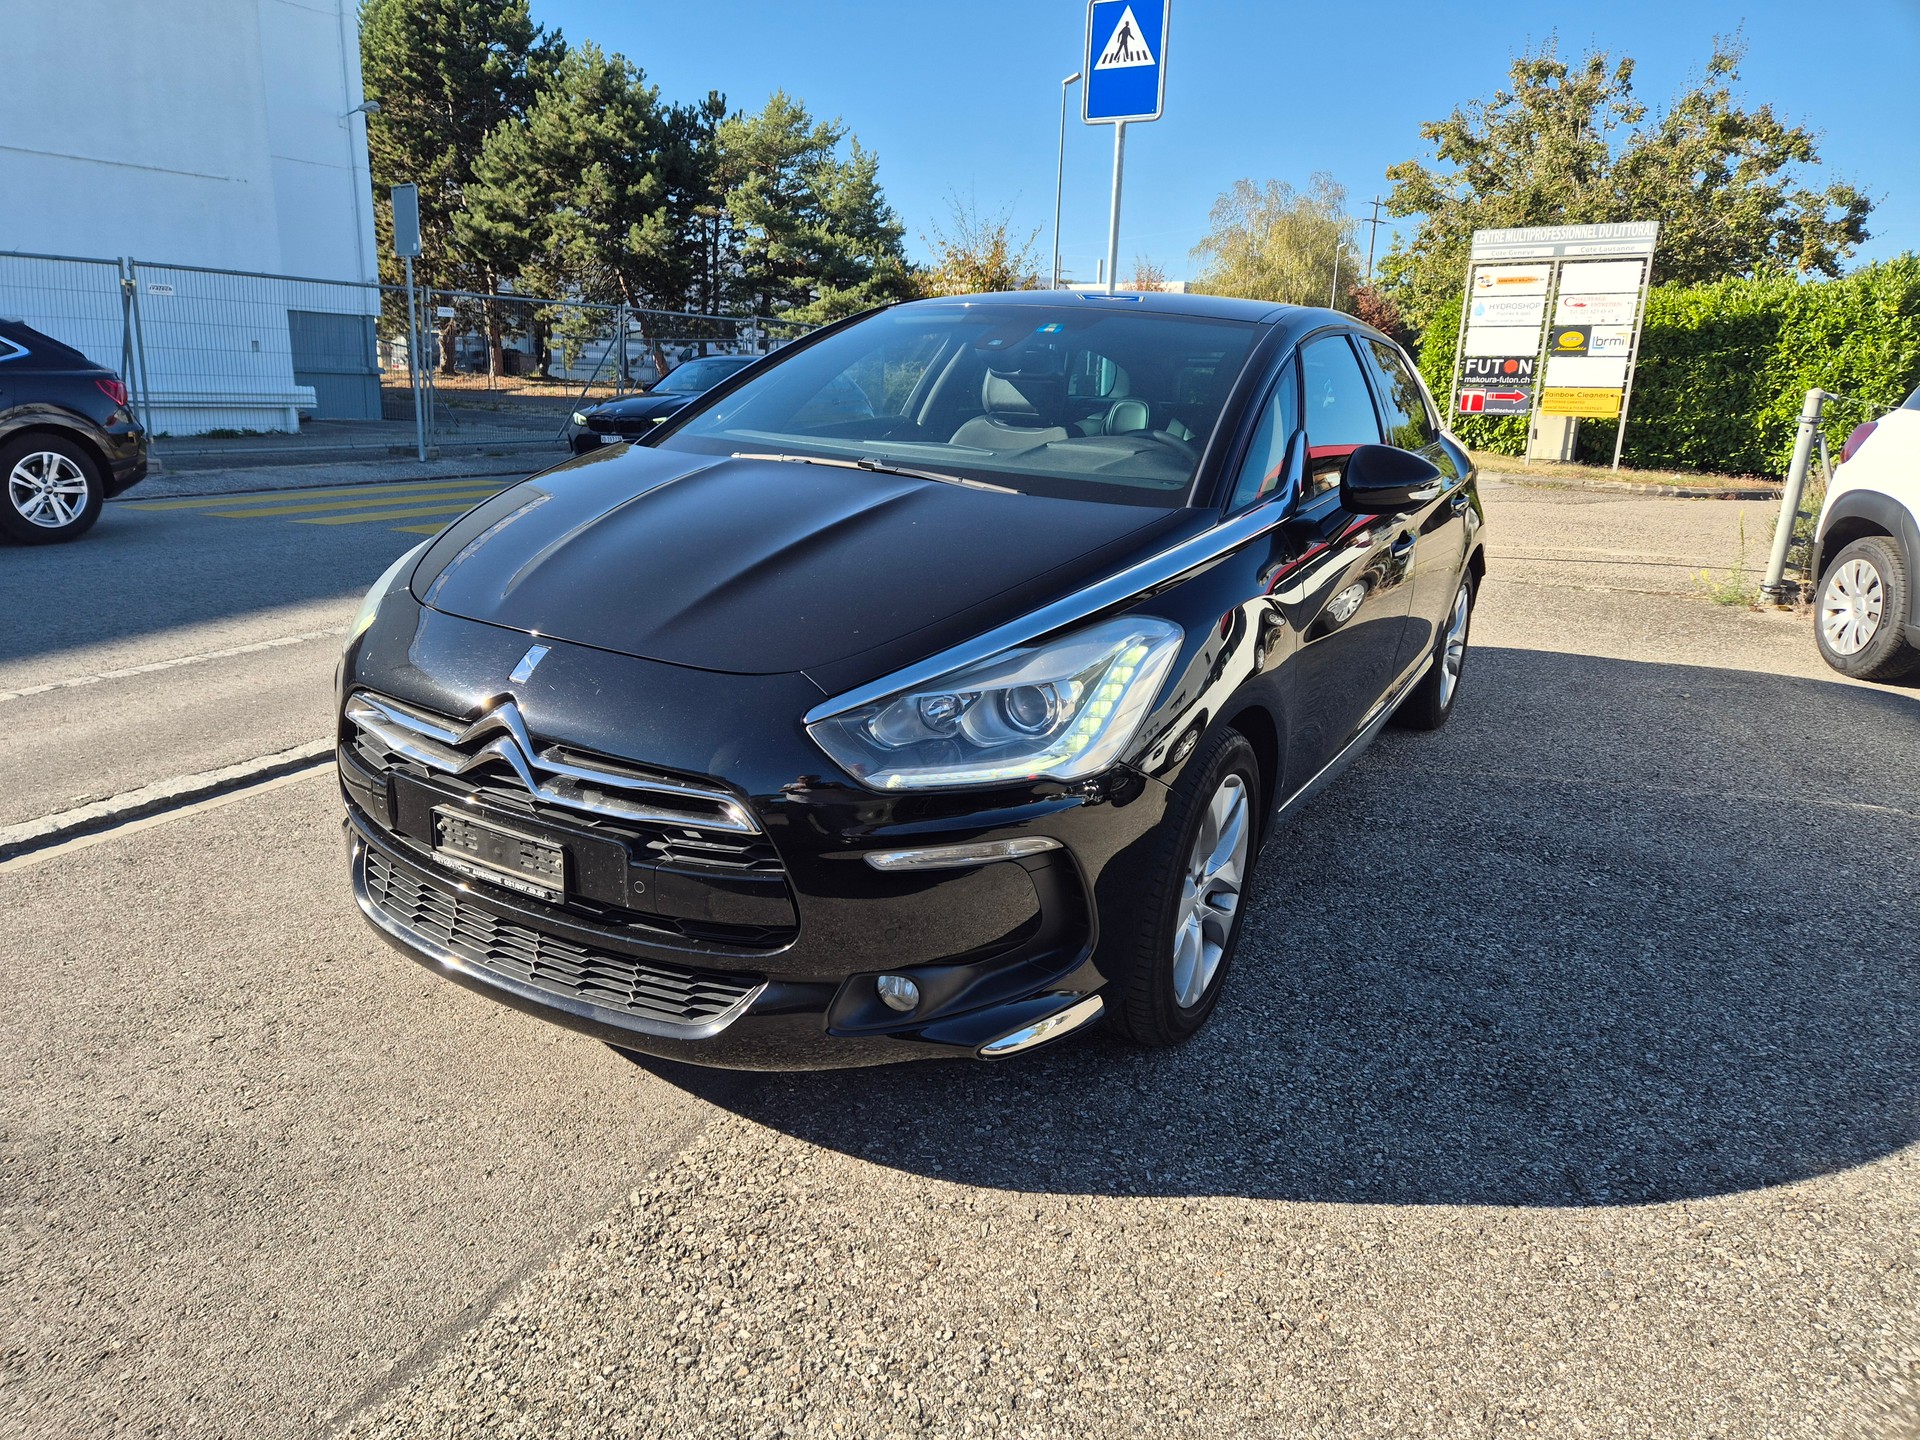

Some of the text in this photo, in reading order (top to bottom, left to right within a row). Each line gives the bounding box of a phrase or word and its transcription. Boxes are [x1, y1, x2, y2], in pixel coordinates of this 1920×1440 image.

[1474, 222, 1656, 244] CENTRE MULTIPROFESSIONNEL DU LITTORAL
[1599, 244, 1635, 252] Lausanne
[1489, 302, 1541, 310] HYDROSHOP
[1464, 376, 1531, 384] makoura-futon.ch
[1576, 391, 1609, 399] Cleaners
